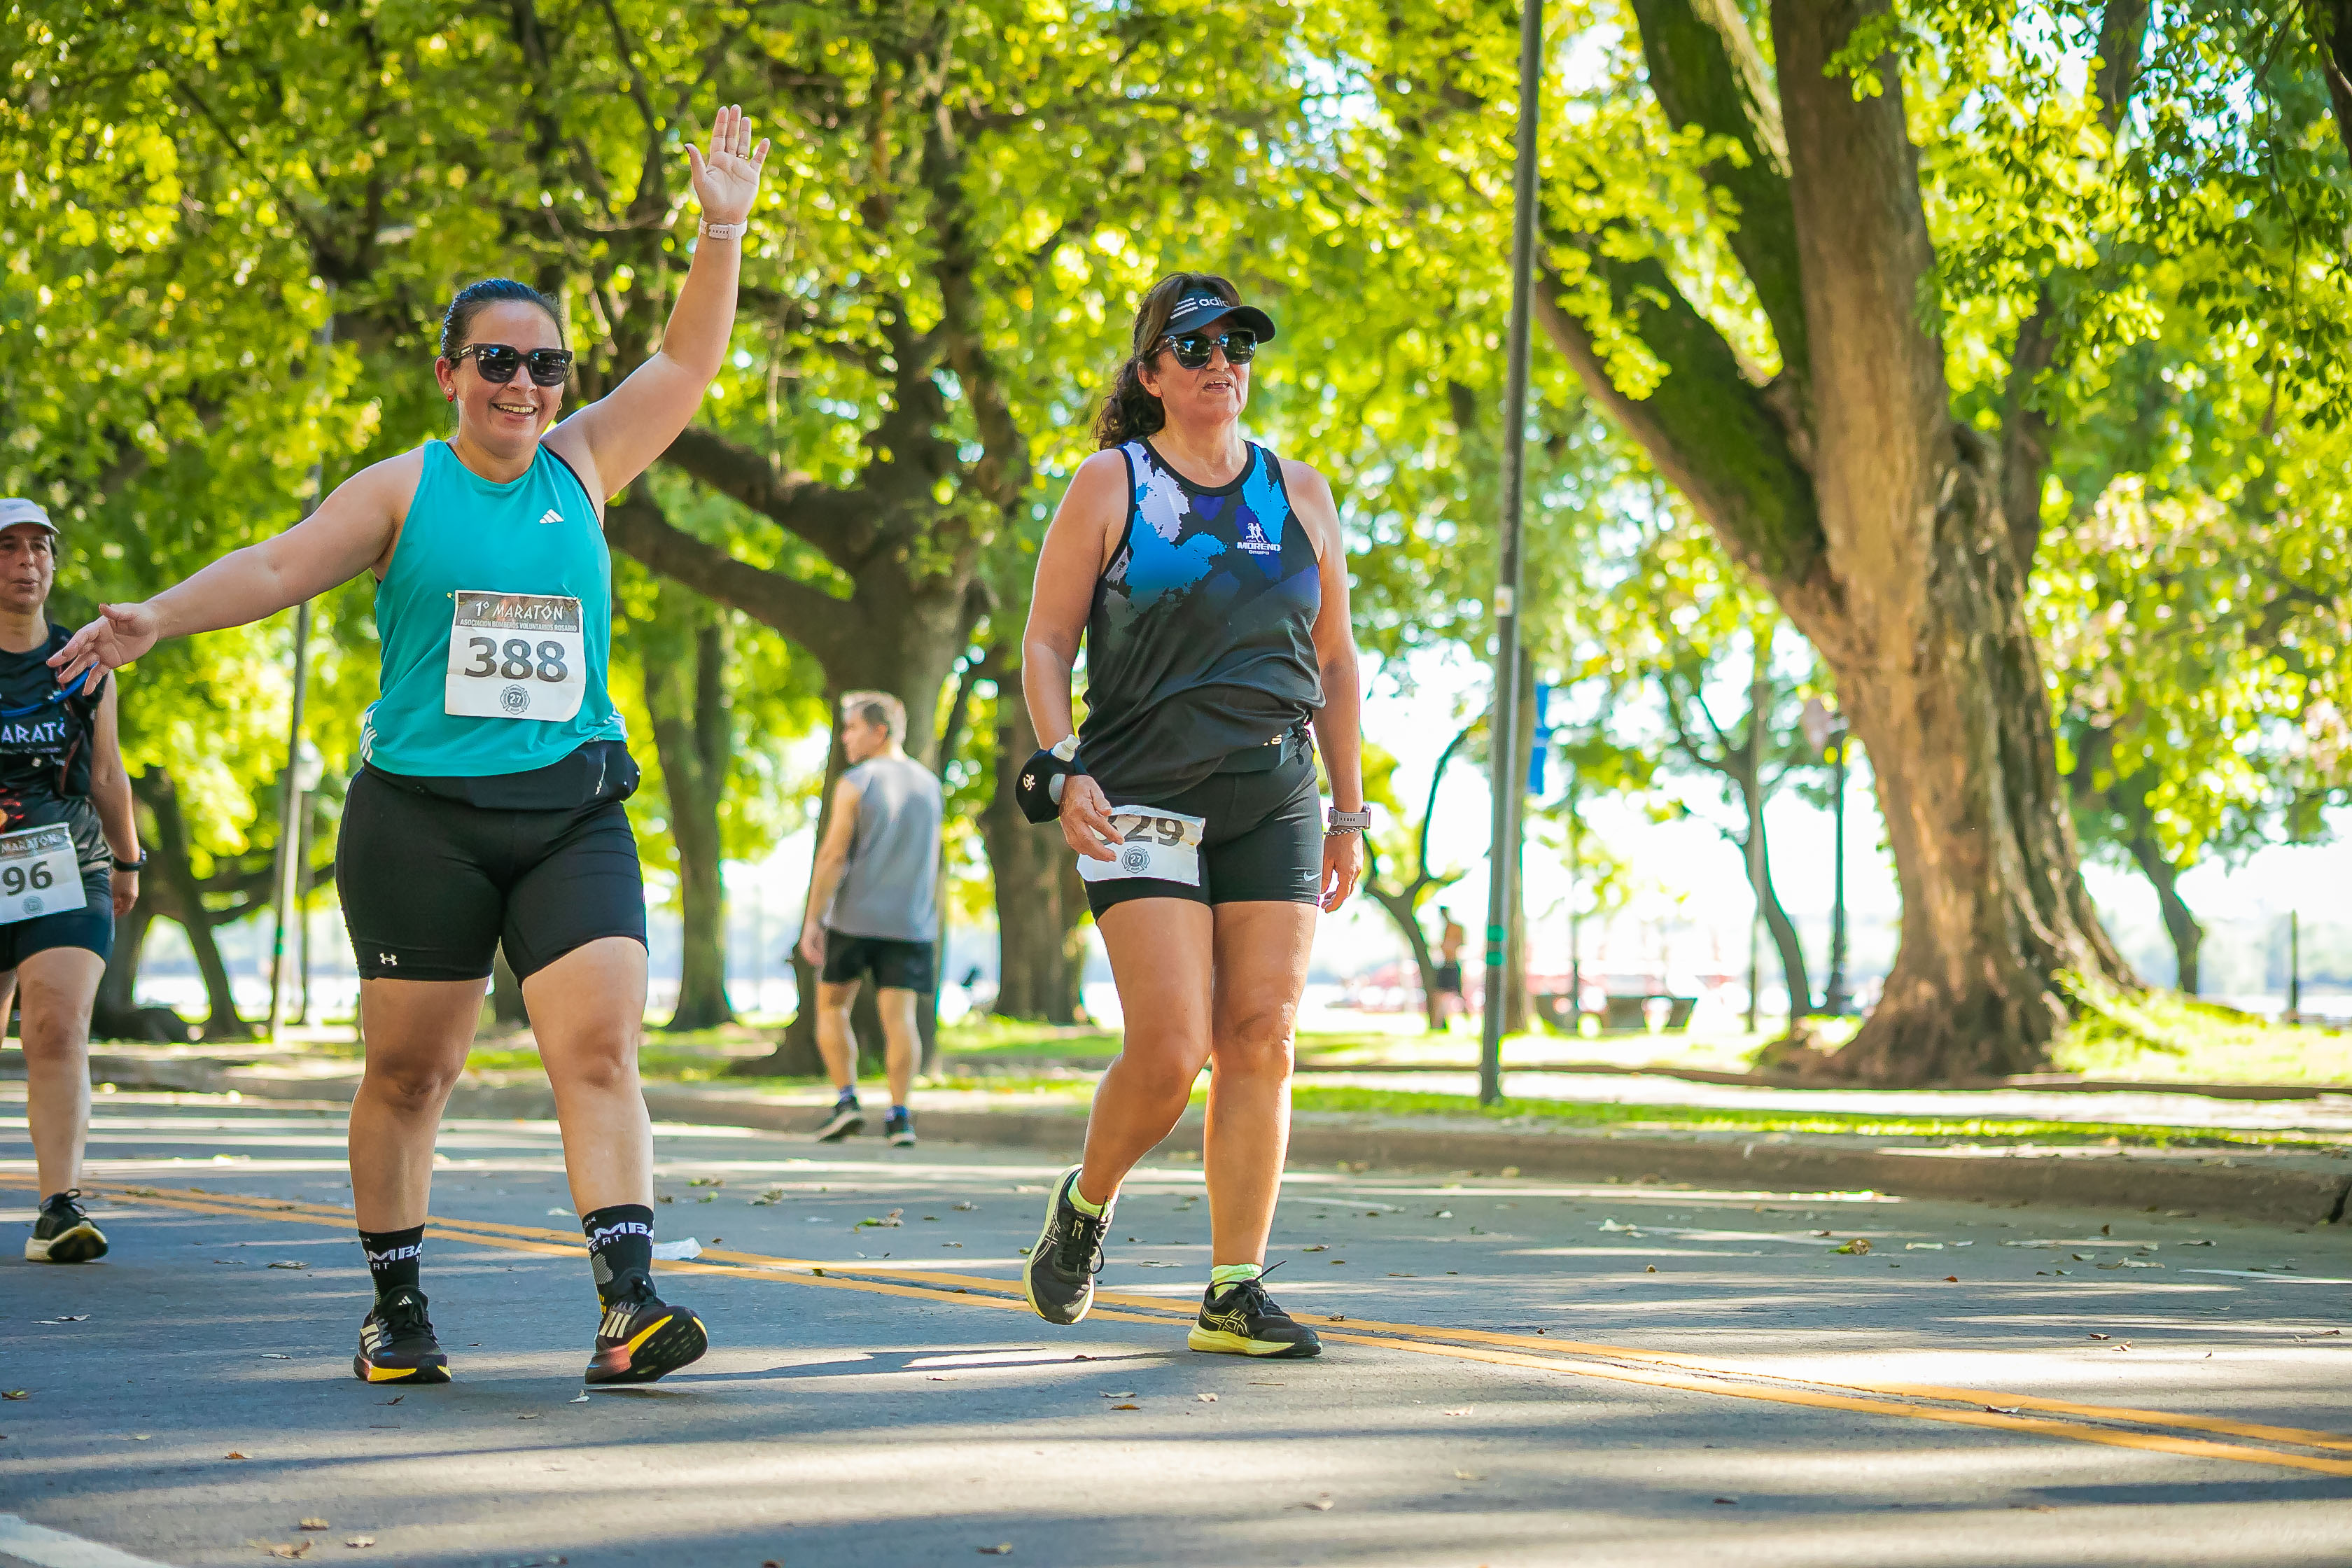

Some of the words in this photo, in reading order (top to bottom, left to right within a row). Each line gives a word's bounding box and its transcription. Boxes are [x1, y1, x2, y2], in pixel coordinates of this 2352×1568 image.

[1237, 542, 1281, 552] MORENO
[492, 601, 564, 621] MARATÓN
[492, 621, 519, 629] BOMBEROS
[519, 622, 554, 631] VOLUNTARIOS
[554, 624, 578, 633] ROSARIO
[464, 636, 568, 682] 388
[510, 693, 522, 704] 27
[1103, 815, 1184, 846] 29
[1130, 854, 1142, 864] 27
[3, 861, 52, 896] 96
[368, 1242, 423, 1262] MBA
